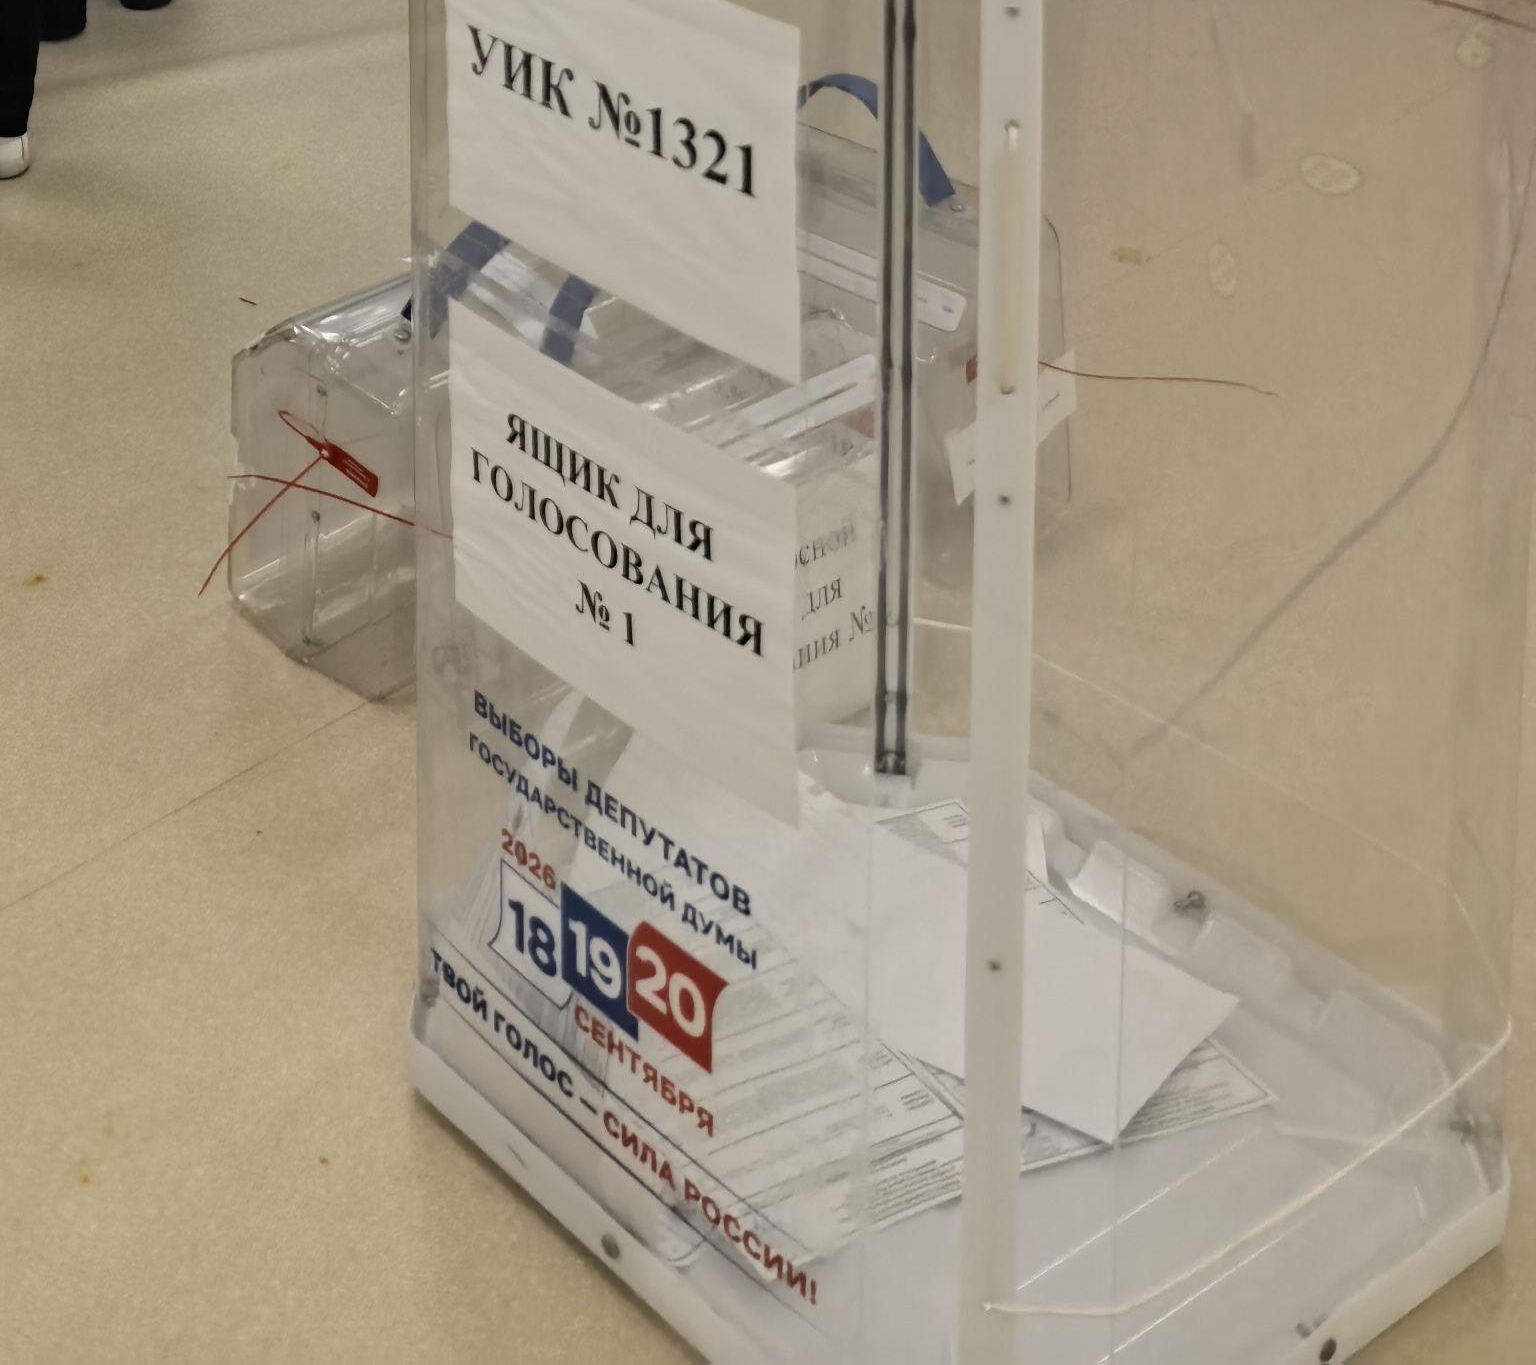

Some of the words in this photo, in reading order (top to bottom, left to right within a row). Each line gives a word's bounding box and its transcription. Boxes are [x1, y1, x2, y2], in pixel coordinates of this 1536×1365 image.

[466, 23, 574, 119] УИК
[588, 79, 758, 199] №1321
[470, 446, 764, 657] ГОЛОСОВАНИЯ
[506, 413, 620, 510] ЯЩИК
[629, 485, 714, 562] ДЛЯ
[575, 579, 611, 631] №
[622, 611, 636, 647] 1
[469, 731, 676, 912] ГОСУДАРСТВЕННОЙ
[681, 902, 757, 971] ДУМЫ
[474, 689, 578, 792] ВЫБОРЫ
[584, 779, 752, 917] ДЕПУТАТОВ
[501, 828, 557, 891] 2026
[508, 899, 557, 978] 18
[568, 918, 622, 1000] 19
[635, 945, 706, 1038] 20
[430, 948, 488, 1021] ТВОЙ
[493, 1009, 574, 1098] ГОЛОС
[602, 1110, 677, 1191] СИЛА
[683, 1177, 818, 1305] РОССИИ!
[574, 999, 713, 1138] СЕНТЯБРЯ
